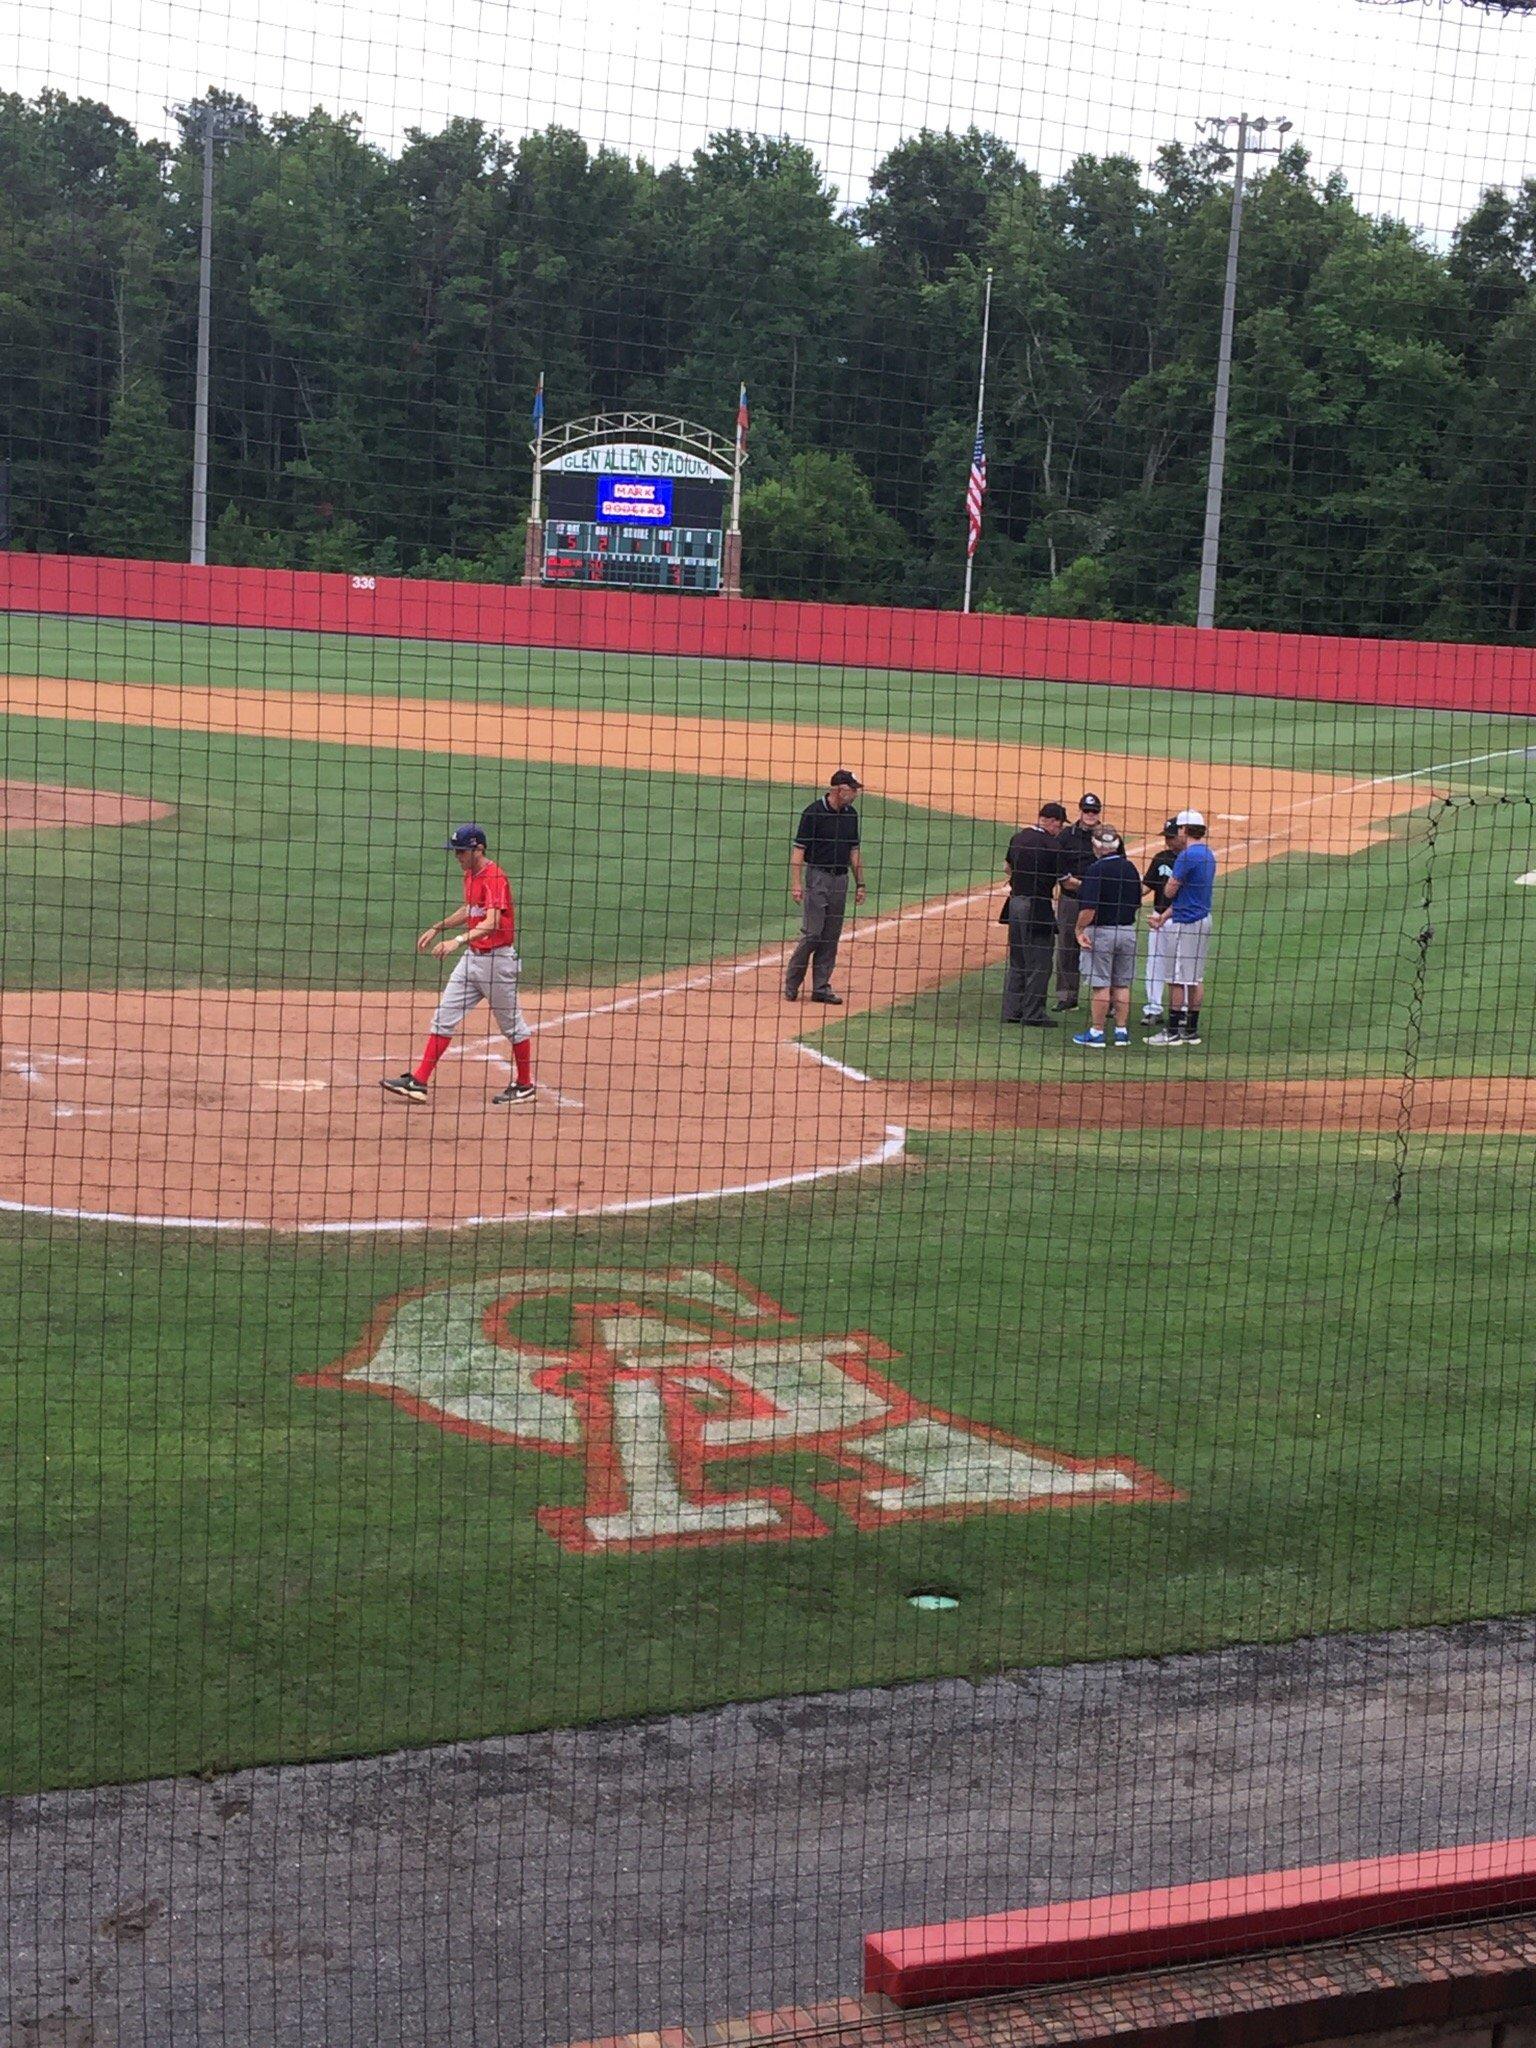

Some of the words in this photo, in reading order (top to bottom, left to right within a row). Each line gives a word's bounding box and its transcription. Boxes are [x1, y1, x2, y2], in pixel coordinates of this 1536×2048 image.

[565, 450, 599, 470] GLEN
[604, 448, 647, 472] ALLEN
[652, 450, 709, 476] STADIUM
[614, 484, 655, 499] MARK
[352, 576, 376, 590] 336
